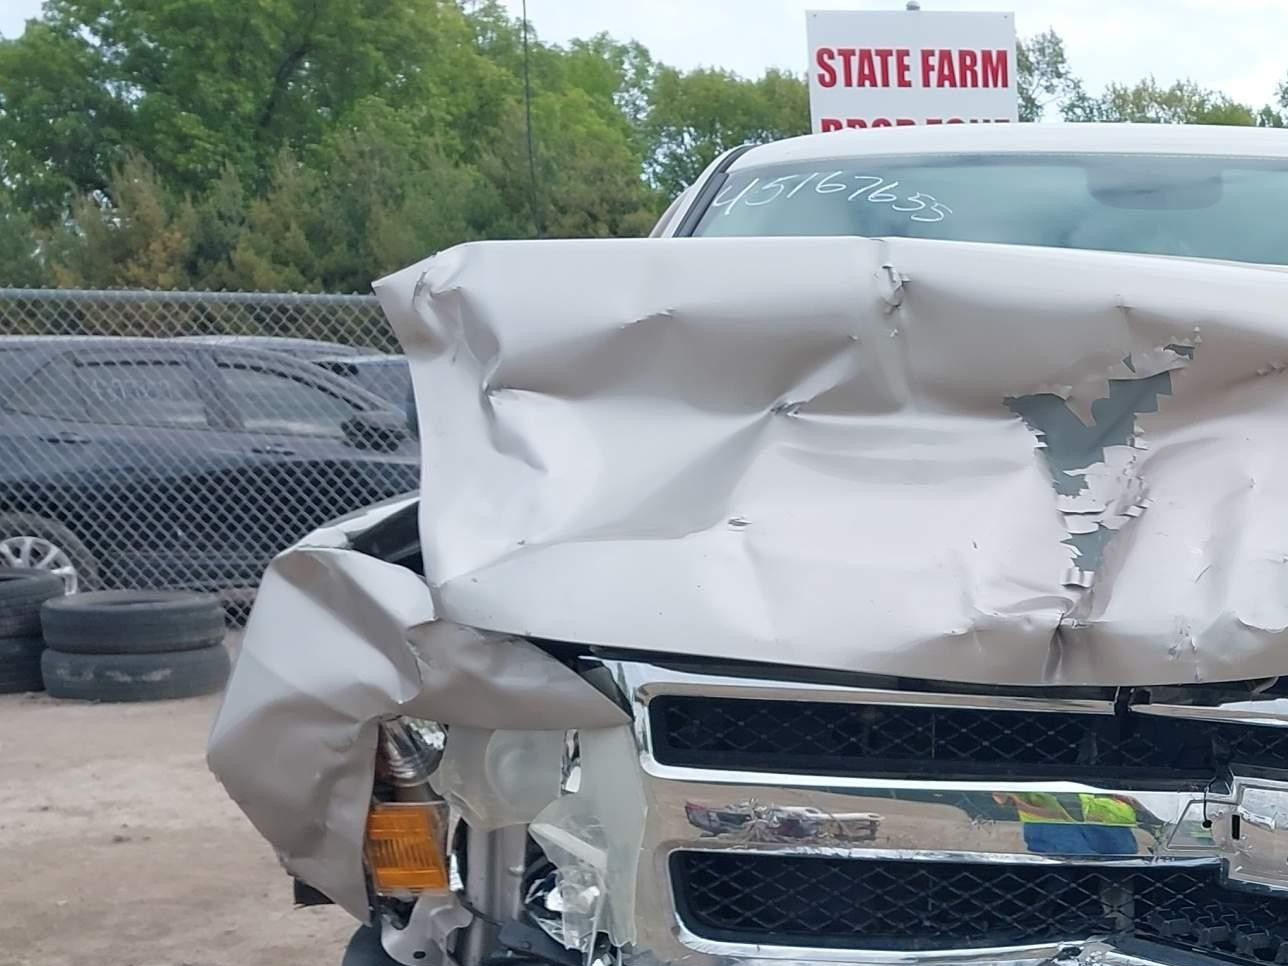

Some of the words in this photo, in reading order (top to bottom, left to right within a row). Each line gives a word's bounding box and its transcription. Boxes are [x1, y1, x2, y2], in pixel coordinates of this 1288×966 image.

[816, 47, 912, 88] STATE
[920, 49, 1009, 88] FARM
[712, 170, 953, 222] 45167655
